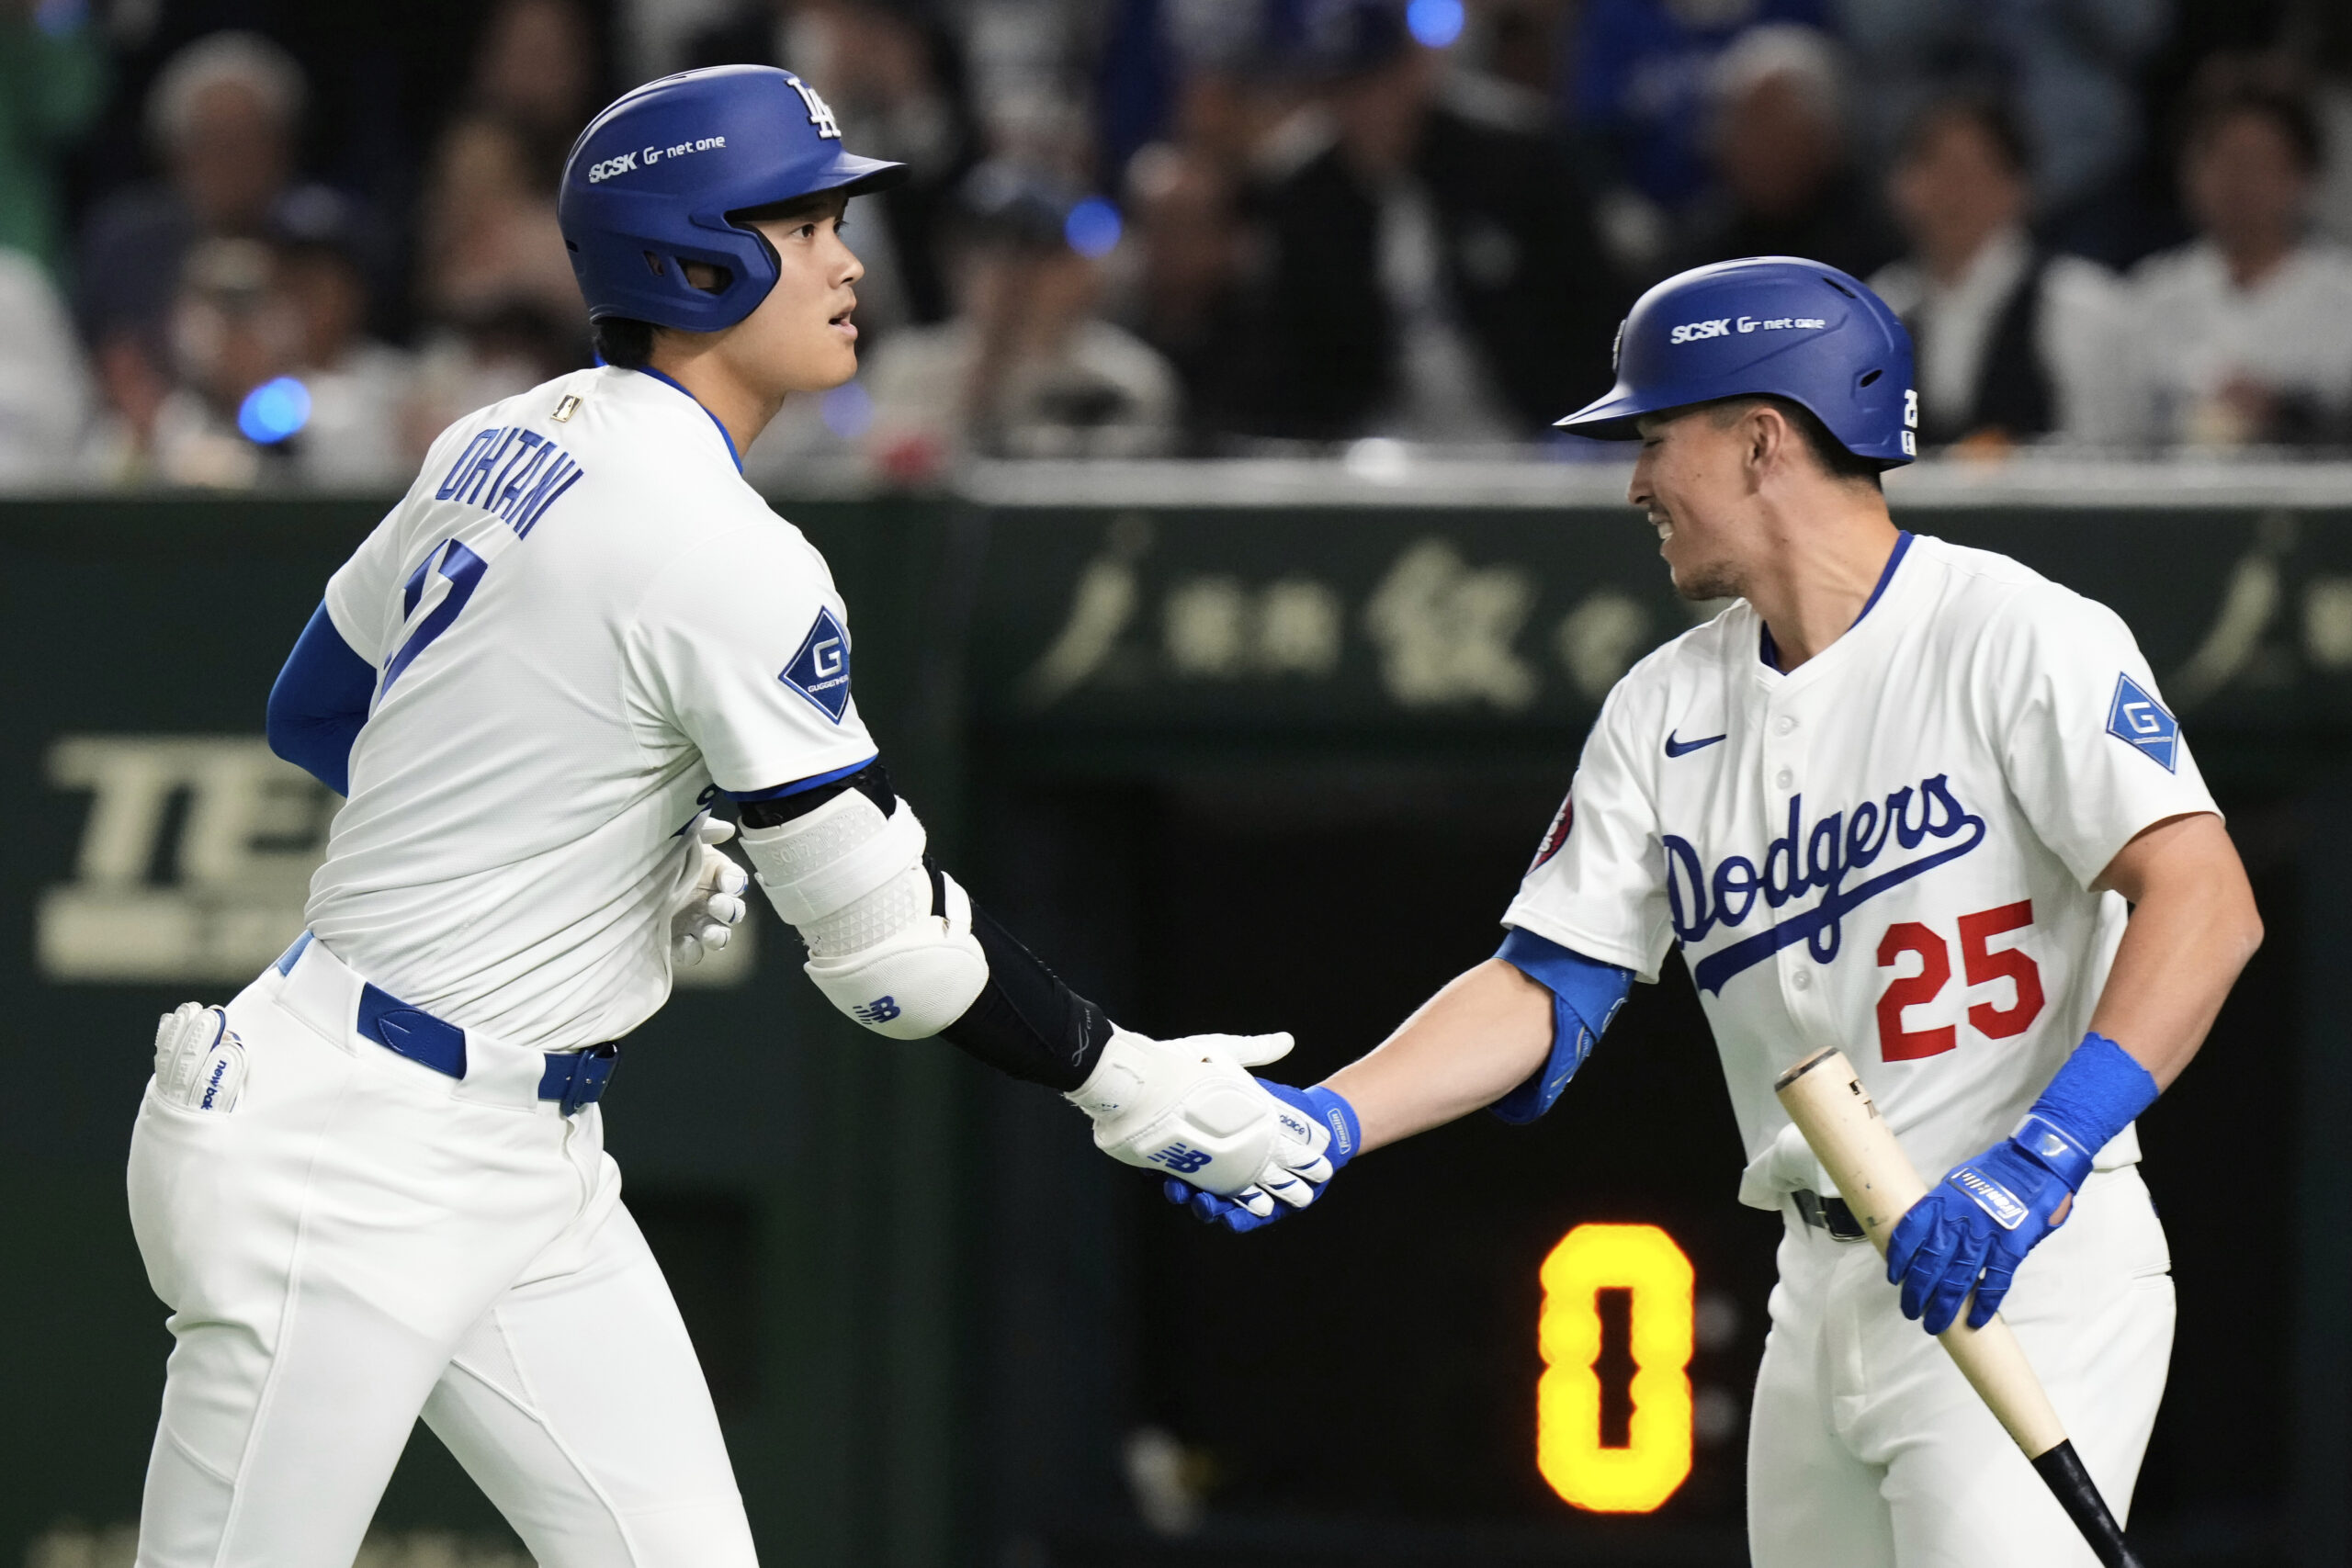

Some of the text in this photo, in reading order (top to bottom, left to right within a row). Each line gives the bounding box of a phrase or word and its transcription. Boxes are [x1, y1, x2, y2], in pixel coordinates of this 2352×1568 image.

[589, 136, 726, 183] SCSK net one
[1670, 318, 1731, 344] SCSK
[1763, 318, 1793, 330] net
[435, 425, 585, 541] OHTANI
[813, 636, 842, 678] G
[2122, 701, 2160, 734] G
[1663, 773, 1980, 970] Dodgers
[1876, 898, 2045, 1063] 25
[209, 1059, 227, 1088] new
[1961, 1172, 2023, 1219] Franklin
[1537, 1222, 1694, 1513] 0
